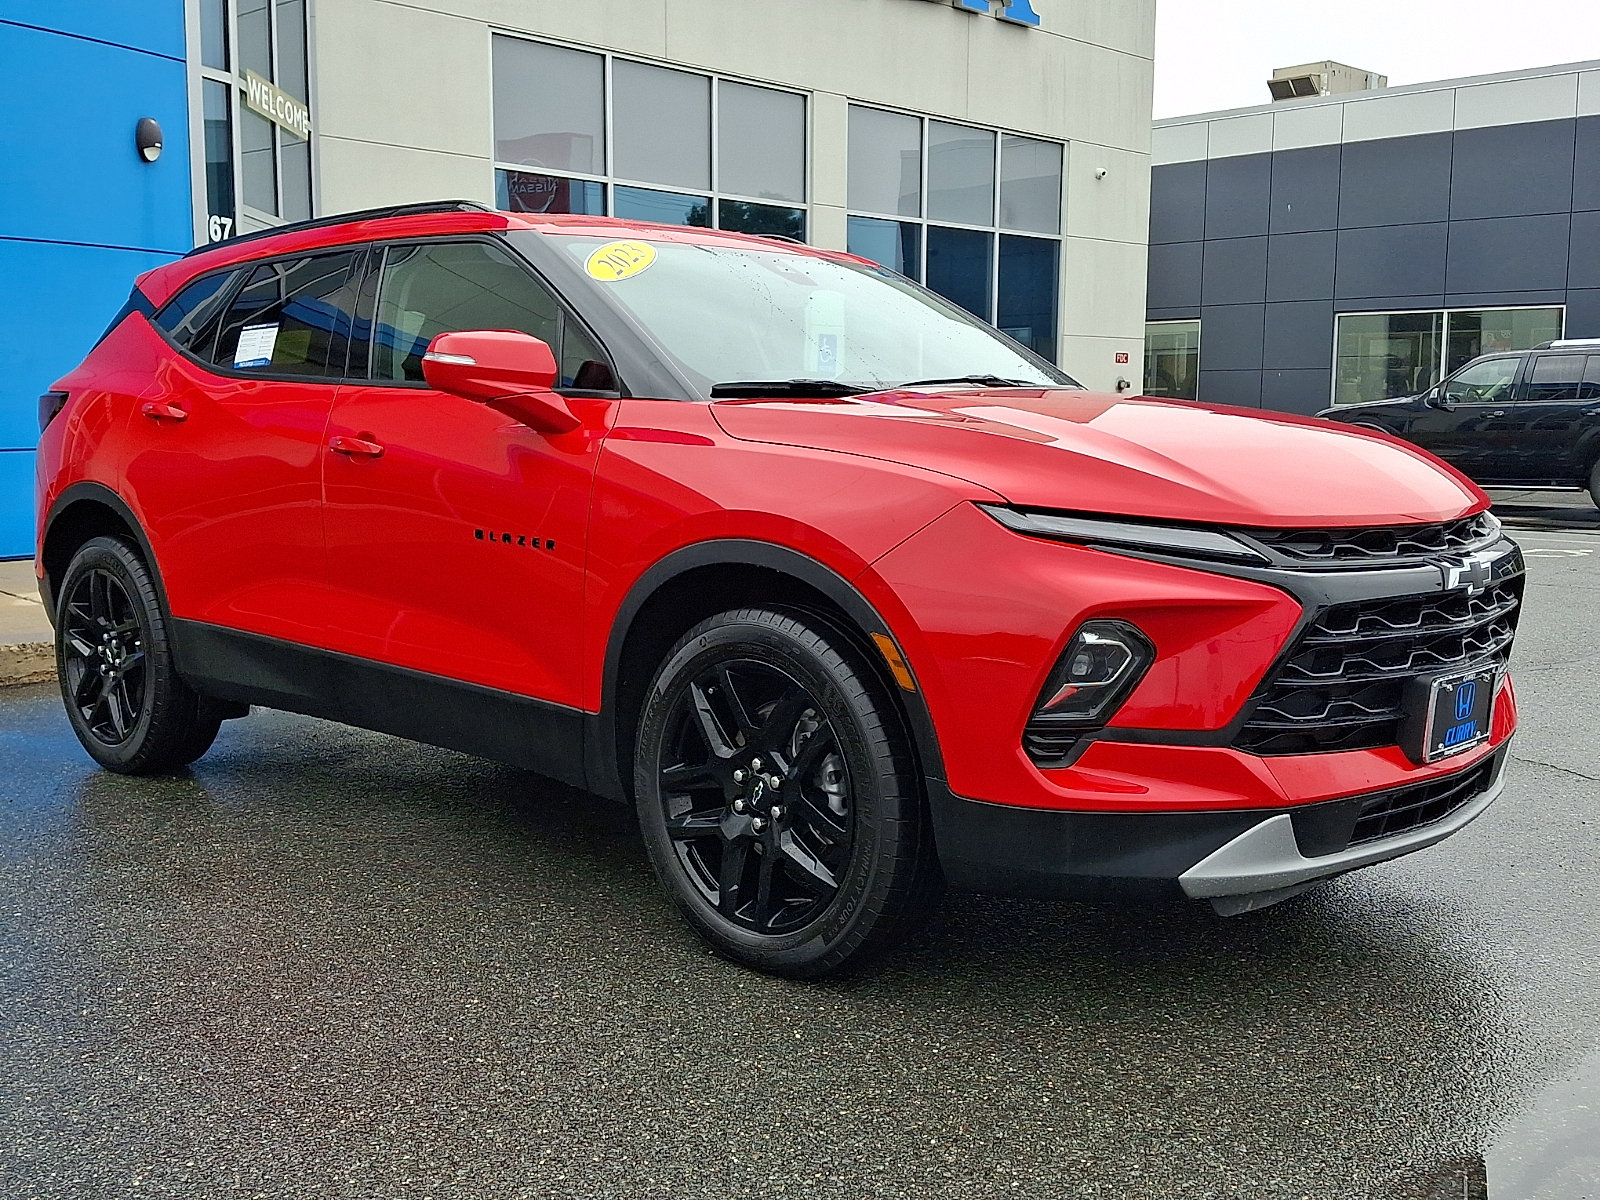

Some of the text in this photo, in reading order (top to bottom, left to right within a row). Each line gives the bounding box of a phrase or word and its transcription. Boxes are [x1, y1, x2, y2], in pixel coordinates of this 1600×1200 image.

[247, 75, 309, 134] WELCOME
[207, 214, 233, 243] 67
[598, 243, 646, 276] 2023
[1116, 353, 1128, 363] FDC
[474, 528, 555, 551] BLAZER
[1444, 720, 1478, 747] CURRY
[839, 838, 873, 924] PRIMACY TOUR
